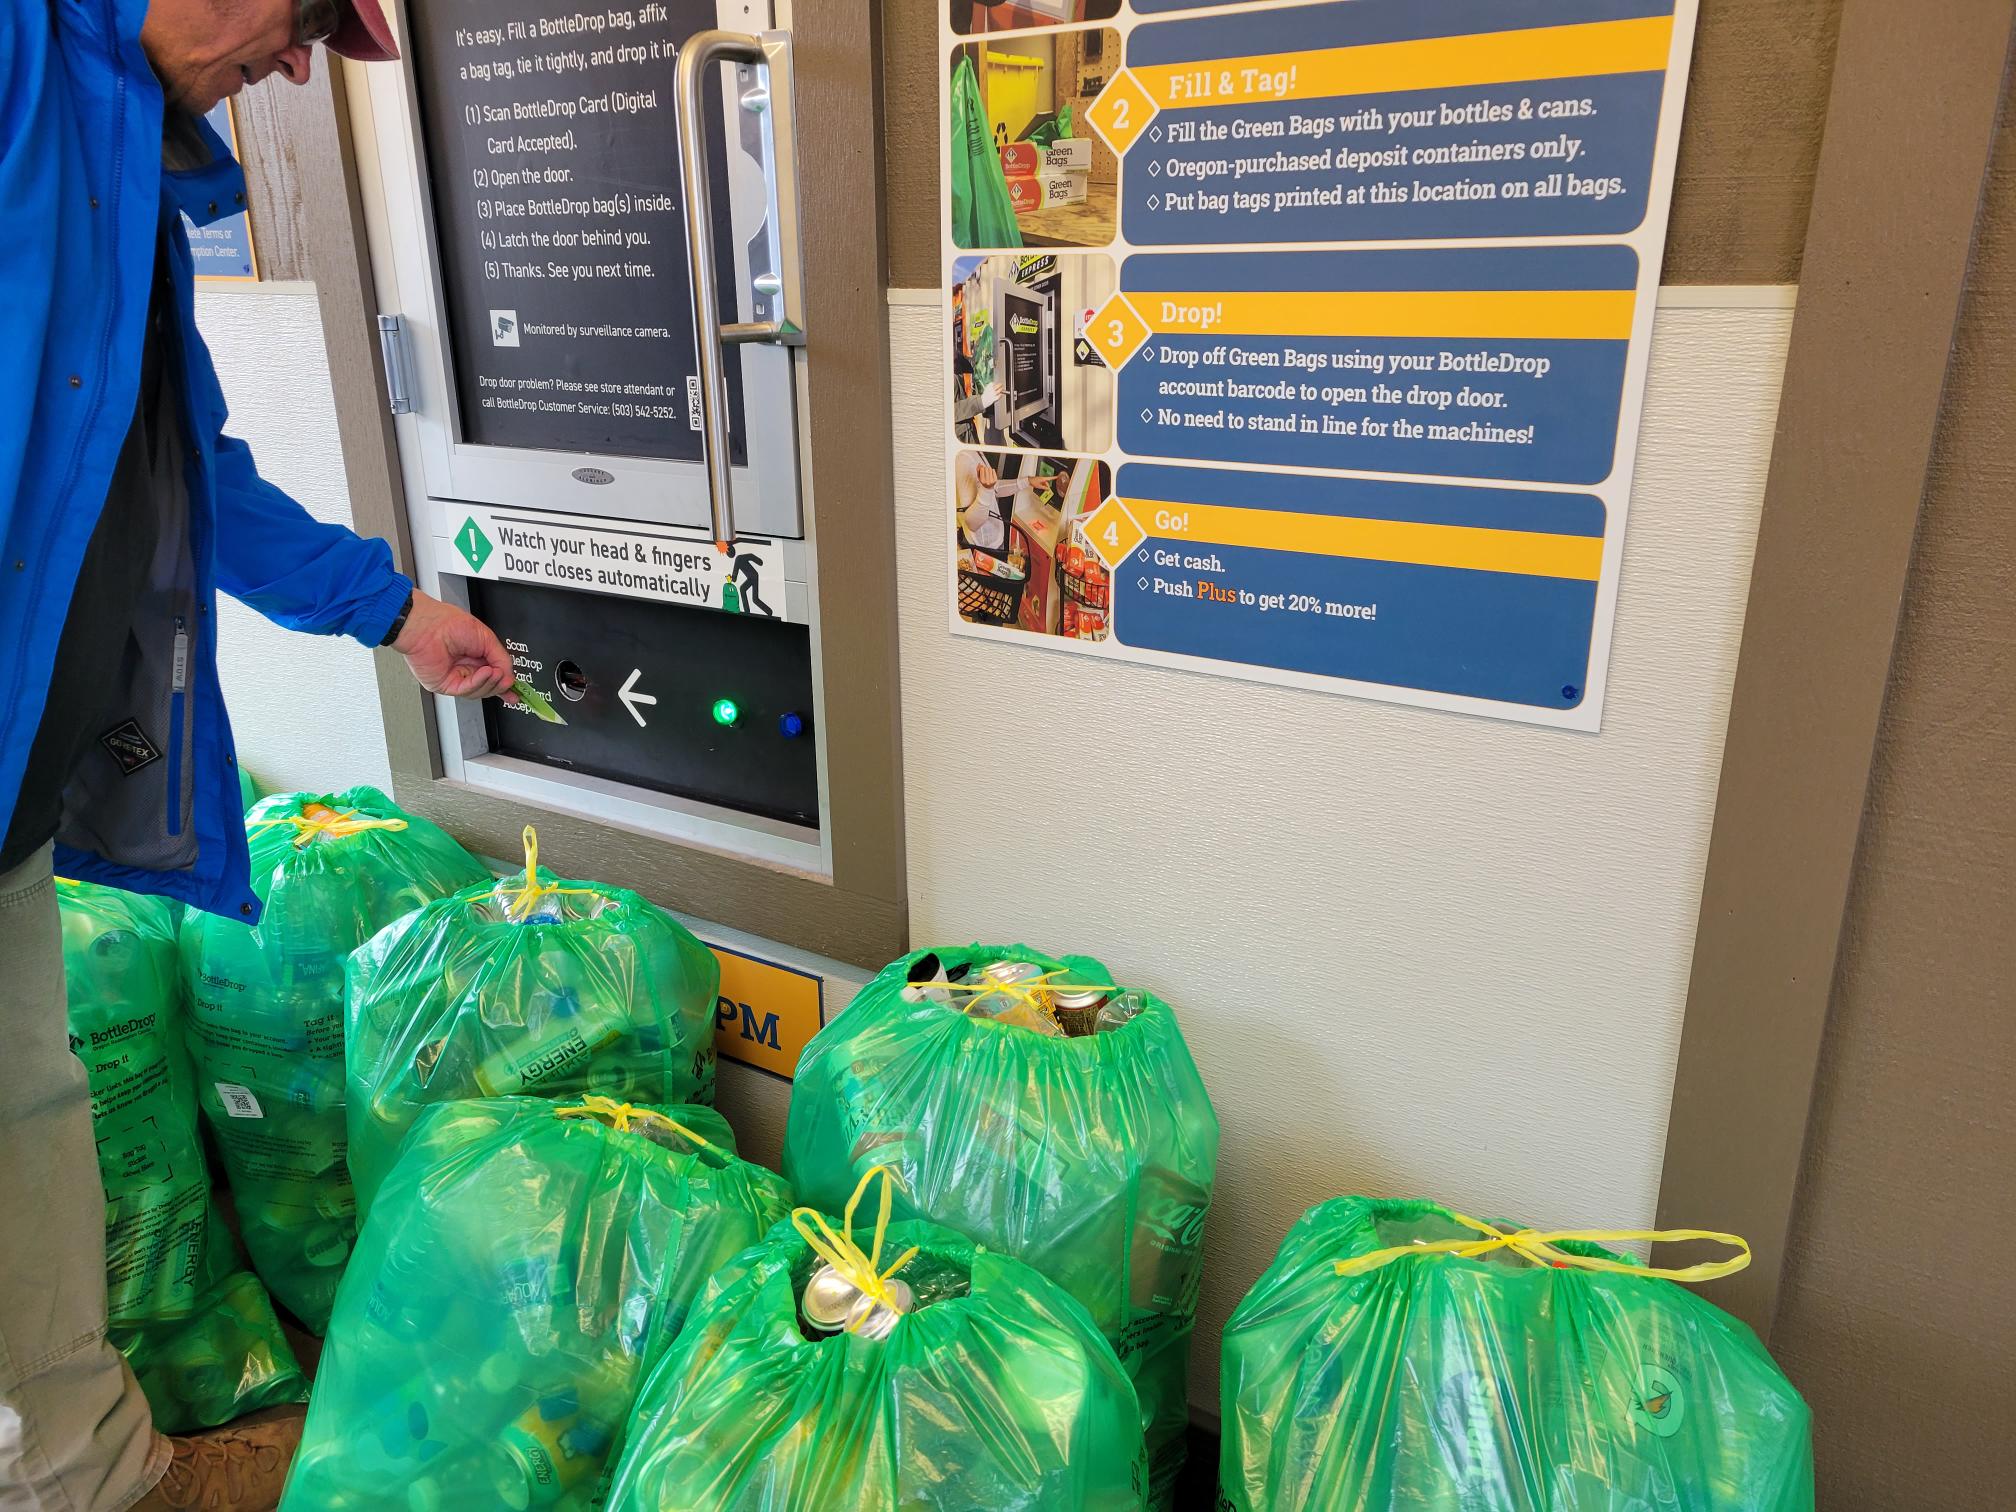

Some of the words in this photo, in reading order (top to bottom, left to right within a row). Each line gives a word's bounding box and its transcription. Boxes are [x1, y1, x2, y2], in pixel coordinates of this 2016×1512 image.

[456, 29, 473, 47] It's
[476, 28, 505, 44] easy.
[508, 21, 526, 40] Fill
[529, 25, 537, 37] a
[540, 13, 605, 36] BottleDrop
[608, 8, 636, 28] bag,
[639, 4, 668, 23] affix
[460, 66, 467, 79] a
[470, 60, 490, 82] bag
[493, 60, 515, 78] tag,
[517, 56, 532, 74] tie
[535, 54, 544, 71] it
[546, 48, 588, 74] tightly,
[591, 46, 614, 65] and
[617, 43, 647, 63] drop
[650, 41, 659, 58] it
[663, 39, 679, 57] in.
[1169, 73, 1211, 100] Fill
[1218, 72, 1234, 95] &
[1241, 65, 1297, 97] Tag!
[465, 103, 481, 125] (1)
[483, 103, 510, 122] Scan
[514, 98, 576, 119] BottleDrop
[579, 95, 608, 114] Card
[612, 90, 657, 112] (Digital
[1112, 99, 1130, 129] 2
[1167, 122, 1195, 143] Fill
[1200, 121, 1228, 141] the
[1232, 118, 1285, 139] Green
[1289, 114, 1334, 139] Bags
[1339, 109, 1383, 132] with
[1388, 108, 1436, 134] your
[1440, 100, 1513, 126] bottles
[1518, 98, 1533, 120] &
[1538, 98, 1598, 119] cans.
[488, 137, 514, 154] Card
[517, 129, 577, 153] Accepted).
[1046, 156, 1068, 167] Bags
[1166, 148, 1331, 180] Oregon-purchased
[1335, 144, 1408, 173] deposit
[1412, 139, 1525, 165] containers
[1530, 135, 1585, 163] only.
[473, 168, 489, 188] (2)
[491, 170, 519, 187] Open
[522, 168, 541, 184] the
[543, 167, 574, 183] door.
[1049, 180, 1073, 190] Green
[477, 200, 493, 219] (3)
[495, 201, 525, 217] Place
[528, 198, 590, 217] BottleDrop
[593, 193, 631, 216] bag(s)
[634, 194, 675, 211] inside.
[1049, 189, 1068, 199] Bags
[1165, 191, 1196, 211] Put
[1199, 190, 1229, 213] bag
[1233, 190, 1270, 214] tags
[1273, 184, 1342, 210] printed
[1346, 187, 1365, 205] at
[1370, 182, 1408, 204] this
[1412, 178, 1496, 202] location
[1501, 181, 1529, 199] on
[1533, 174, 1562, 197] all
[1567, 173, 1626, 200] bags.
[202, 227, 224, 240] Terms
[225, 229, 232, 239] or
[481, 231, 496, 250] (4)
[499, 231, 528, 248] Latch
[531, 230, 550, 247] the
[552, 230, 579, 246] door
[581, 229, 622, 246] behind
[625, 232, 651, 249] you.
[215, 244, 240, 258] Center.
[485, 261, 500, 280] (5)
[502, 261, 545, 278] Thanks.
[548, 262, 569, 278] See
[572, 265, 593, 281] you
[596, 262, 621, 278] next
[624, 261, 655, 278] time.
[1161, 302, 1222, 329] Drop!
[523, 322, 565, 337] Monitored
[567, 323, 577, 339] by
[579, 323, 632, 337] surveillance
[634, 327, 671, 338] camera.
[1107, 319, 1124, 348] 3
[1159, 346, 1199, 369] Drop
[1202, 346, 1226, 365] off
[1229, 349, 1280, 367] Green
[1283, 349, 1328, 372] Bags
[1332, 349, 1384, 374] using
[1389, 355, 1435, 375] your
[1438, 351, 1550, 378] BottleDrop
[479, 375, 497, 389] Drop
[499, 376, 516, 389] door
[518, 377, 554, 391] problem?
[556, 379, 583, 393] Please
[584, 383, 599, 393] see
[600, 383, 622, 394] store
[623, 383, 664, 396] attendant
[665, 386, 676, 396] or
[1159, 380, 1224, 398] account
[1227, 379, 1295, 400] barcode
[1300, 384, 1317, 401] to
[1321, 387, 1367, 406] open
[1371, 384, 1402, 404] the
[1406, 385, 1452, 410] drop
[1456, 387, 1508, 408] door.
[482, 397, 496, 408] call
[496, 397, 537, 413] BottleDrop
[538, 400, 576, 413] Customer
[578, 402, 610, 416] Service:
[612, 402, 633, 418] (503)
[635, 406, 677, 419] 542-5252.
[1158, 409, 1181, 425] No
[1184, 410, 1224, 429] need
[1228, 412, 1244, 429] to
[1248, 413, 1296, 433] stand
[1300, 414, 1318, 434] in
[1322, 415, 1357, 436] line
[1361, 417, 1388, 437] for
[1392, 419, 1424, 439] the
[1428, 422, 1534, 444] machines!
[1103, 521, 1118, 546] 4
[1155, 510, 1189, 532] Go!
[498, 527, 546, 550] Watch
[550, 537, 586, 557] your
[590, 537, 629, 561] head
[634, 544, 647, 563] &
[652, 546, 712, 573] fingers
[1154, 549, 1180, 568] Get
[1183, 553, 1226, 573] cash.
[505, 553, 541, 575] Door
[545, 559, 593, 583] closes
[598, 566, 711, 603] automatically
[1153, 577, 1193, 598] Push
[1197, 581, 1236, 603] Plus
[1239, 589, 1255, 606] to
[1258, 594, 1285, 612] get
[1288, 594, 1322, 614] 20%
[1325, 601, 1377, 621] more!
[505, 638, 529, 652] Scan
[510, 655, 543, 672] leDrop
[514, 670, 533, 683] ard
[90, 1013, 156, 1046] BottleDrop
[304, 1017, 324, 1028] Tag
[716, 995, 781, 1051] PM
[96, 1059, 120, 1073] Drop
[520, 1035, 588, 1086] ENERGY
[184, 1220, 202, 1287] ENERGY
